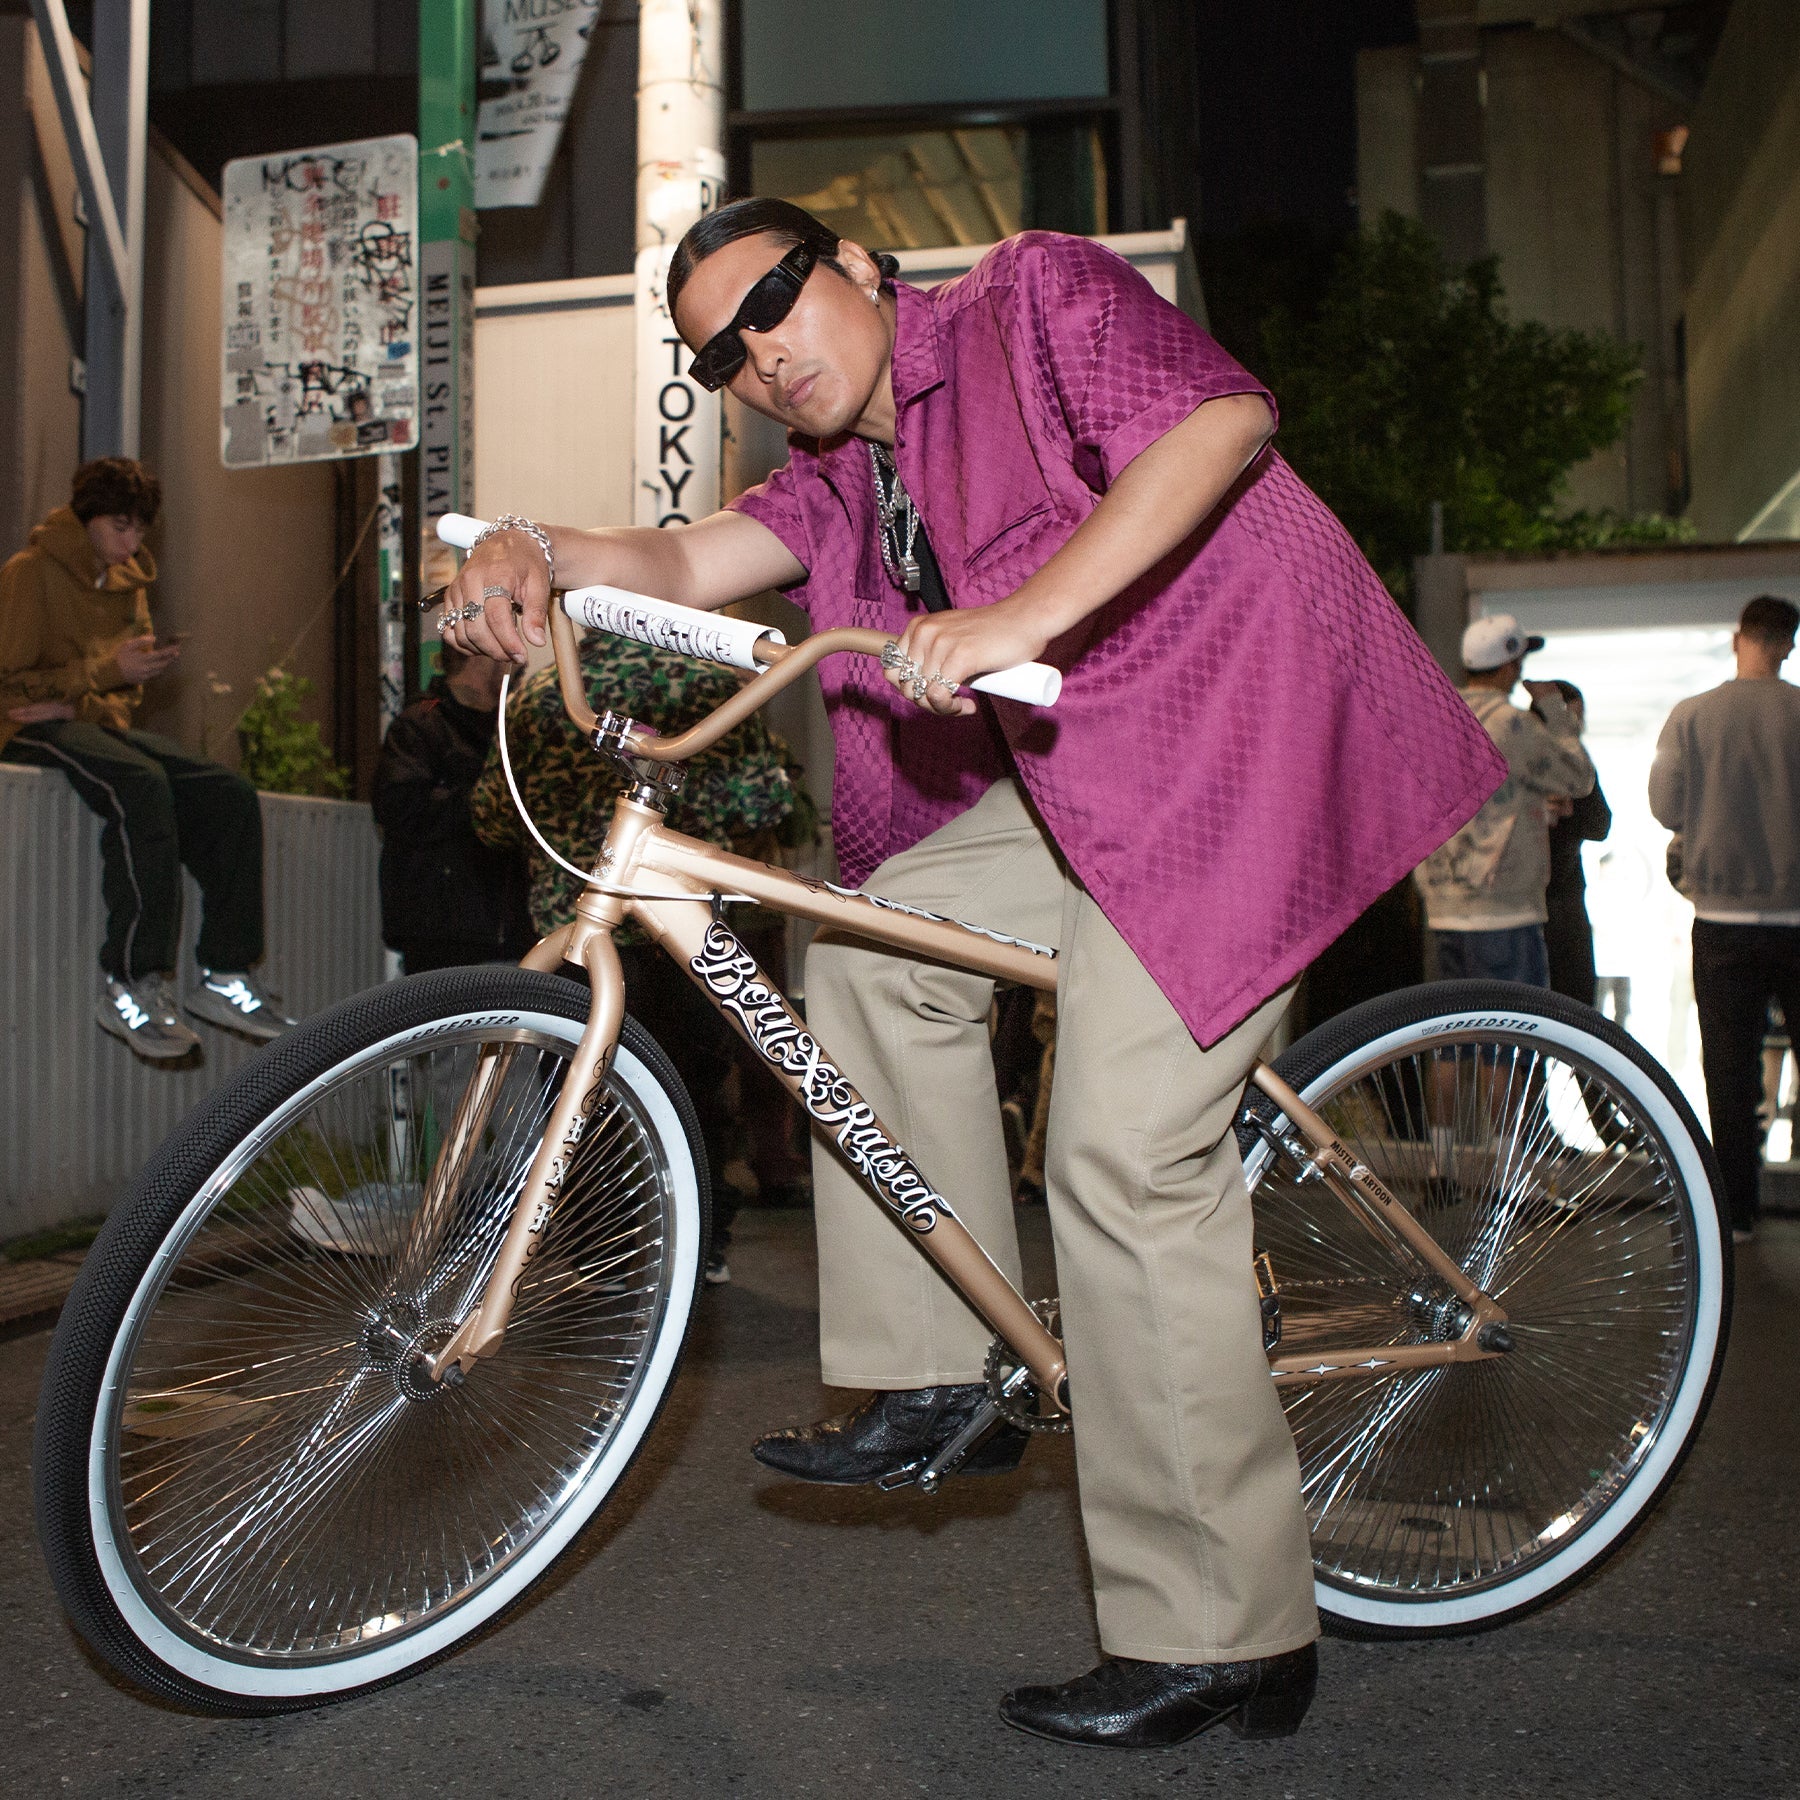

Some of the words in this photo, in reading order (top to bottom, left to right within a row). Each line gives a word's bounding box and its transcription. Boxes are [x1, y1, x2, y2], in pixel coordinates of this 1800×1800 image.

[427, 273, 450, 365] MEIJI
[407, 1015, 520, 1041] SPEEDSTER
[1442, 1018, 1540, 1032] SPEEDSTER
[690, 920, 800, 1063] Born
[805, 1076, 955, 1234] Raised
[1330, 1140, 1358, 1169] MISTER
[1349, 1163, 1392, 1206] CARTOON
